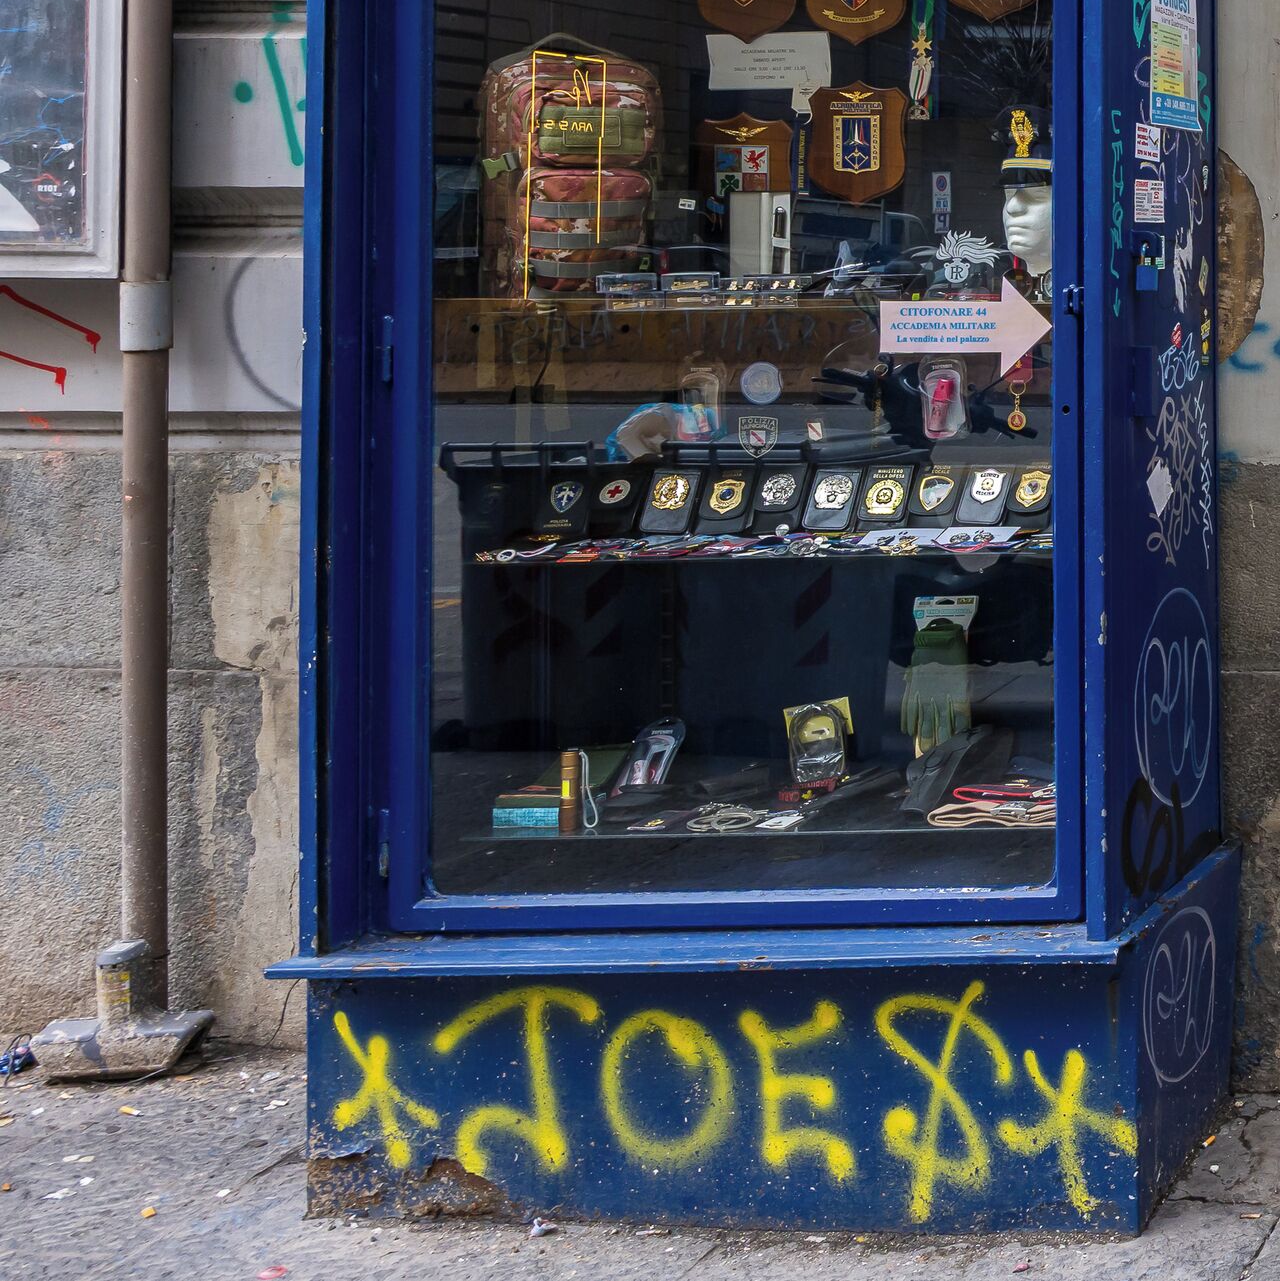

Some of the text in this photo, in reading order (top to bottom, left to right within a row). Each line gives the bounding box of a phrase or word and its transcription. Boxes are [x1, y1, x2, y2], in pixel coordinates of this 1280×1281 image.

[900, 308, 987, 317] CITOFONARE 44
[890, 322, 997, 330] ACCADEMIA MILITARE
[897, 335, 990, 344] La vendita è nel palazzo
[742, 417, 776, 425] POLIZIA
